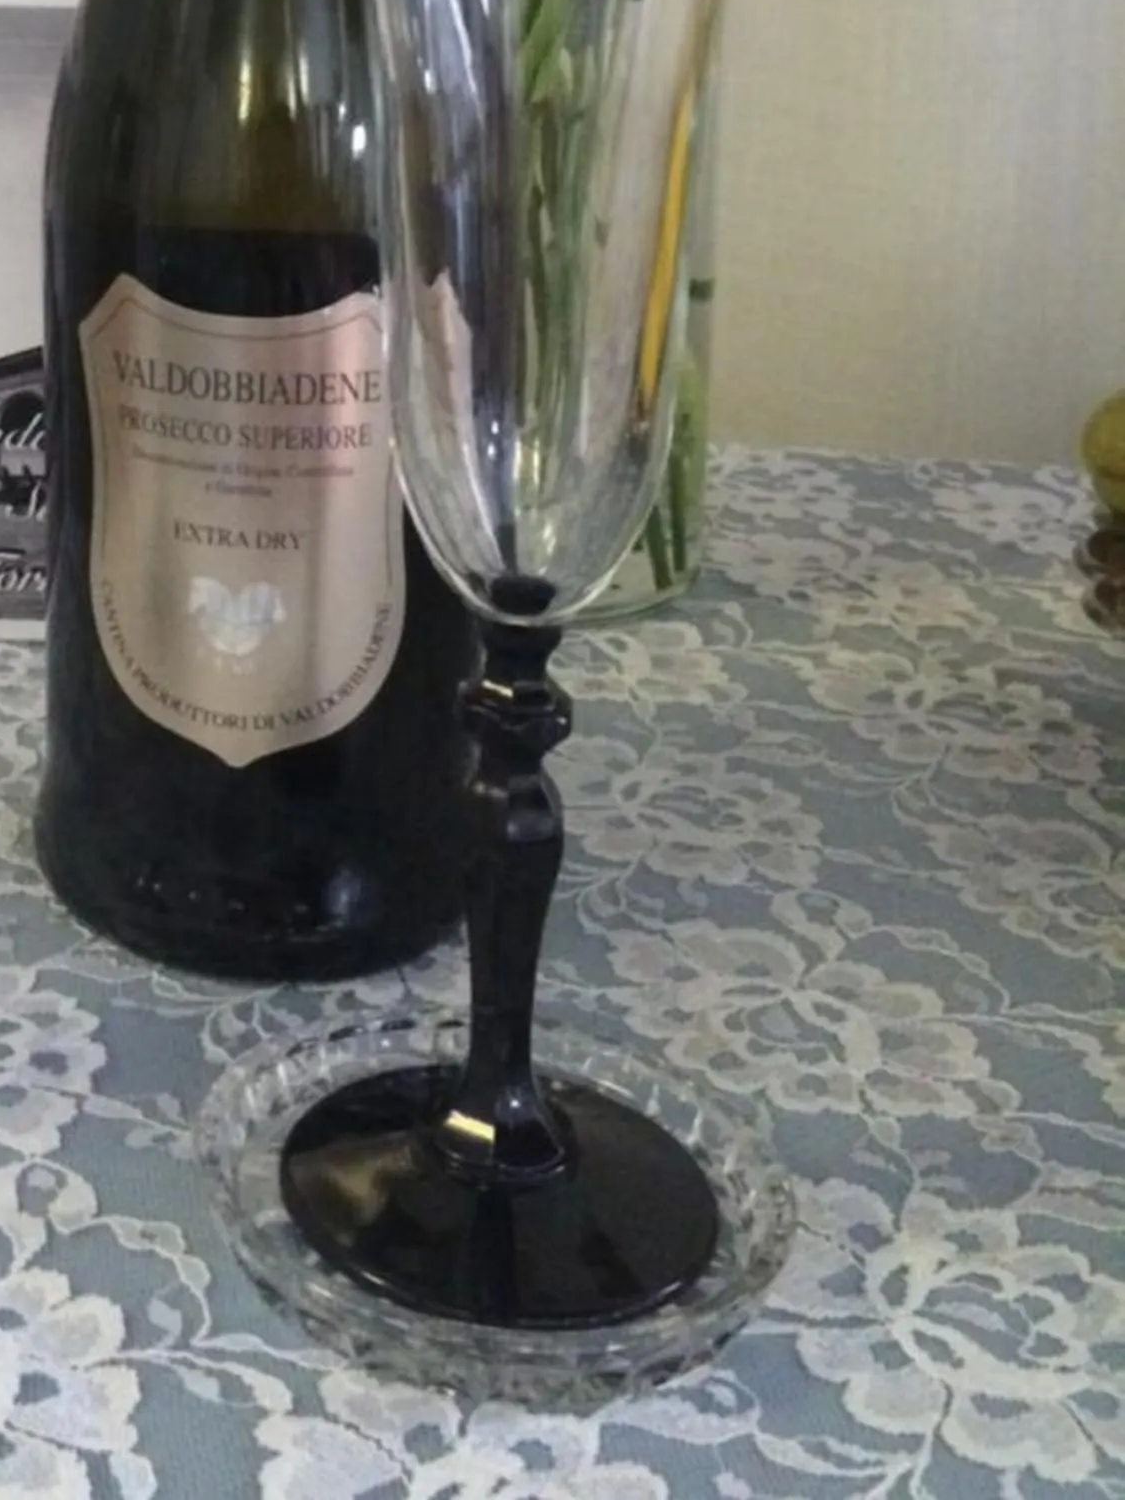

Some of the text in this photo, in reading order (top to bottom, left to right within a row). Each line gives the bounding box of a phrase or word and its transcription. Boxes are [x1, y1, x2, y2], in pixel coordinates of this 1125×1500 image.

[113, 350, 382, 405] VALDOBBIADENE
[119, 403, 373, 451] PROSECCO SUPERIORE
[174, 518, 302, 551] EXTRA DRY
